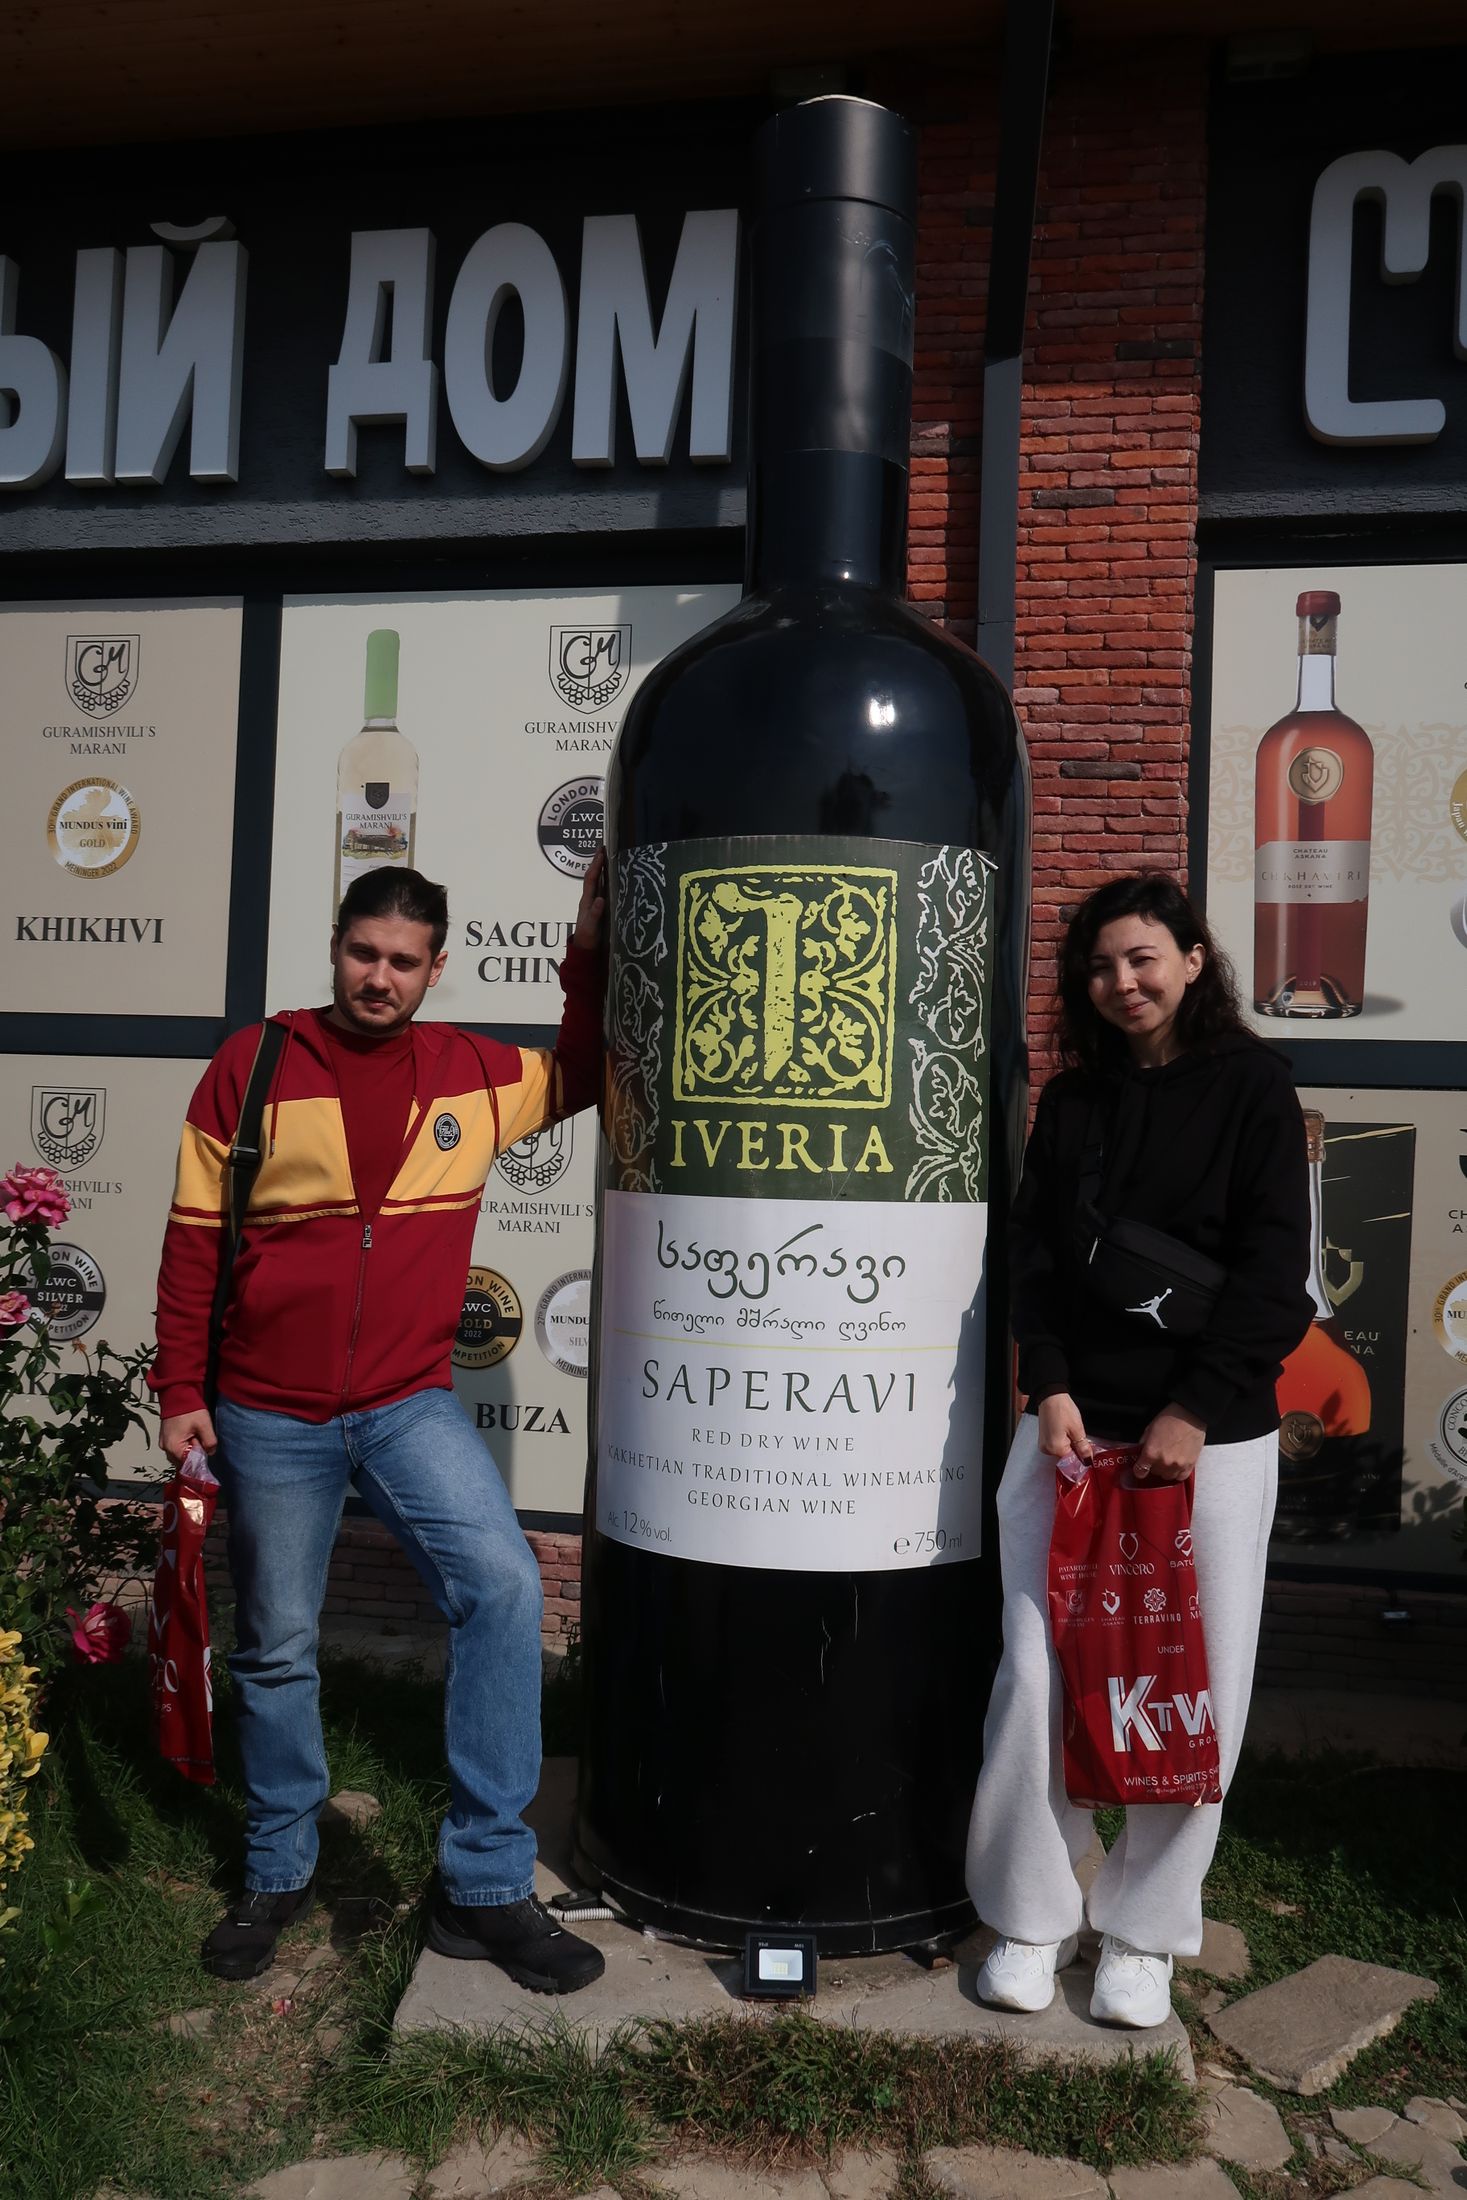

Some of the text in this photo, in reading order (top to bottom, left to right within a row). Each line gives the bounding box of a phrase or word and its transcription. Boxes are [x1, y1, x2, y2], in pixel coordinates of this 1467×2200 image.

[325, 207, 743, 475] ДОМ
[42, 726, 156, 738] GURAMISHVILI'S
[524, 721, 618, 734] GURAMISHV
[70, 743, 126, 754] MARANI
[555, 739, 613, 751] MARAN
[547, 785, 599, 821] LONDON
[59, 818, 128, 830] MUNDUS vini
[562, 828, 603, 839] SILVE
[79, 838, 106, 848] GOLD
[578, 840, 596, 848] 2022
[15, 916, 165, 944] KHIKHVI
[477, 956, 566, 983] CHIN
[670, 1119, 895, 1174] IVERIA
[64, 1180, 123, 1194] SHVILI'S
[69, 1198, 92, 1210] ANI
[479, 1201, 594, 1217] URAMISHVILI'S
[498, 1219, 561, 1234] MARANI
[657, 1219, 907, 1304] საფერავი
[74, 1256, 98, 1289] WINE
[37, 1291, 84, 1304] SILVER
[488, 1280, 515, 1314] WINE
[458, 1318, 493, 1329] OLD
[550, 1315, 590, 1326] MUNDU
[653, 1299, 907, 1341] წითელი მშრალი ღვინო
[463, 1329, 482, 1338] 2022
[568, 1336, 590, 1347] SILV
[451, 1341, 506, 1361] MPETITION
[555, 1357, 588, 1376] MEINING
[642, 1359, 916, 1414] SAPERAVI
[474, 1402, 571, 1434] BUZA
[692, 1428, 855, 1452] RED DRY WINE
[608, 1443, 966, 1488] KAKHETIAN TRADITIONAL WINEMAKING
[1093, 1457, 1115, 1469] EARS
[687, 1489, 856, 1515] GEORGIAN WINE
[1133, 1613, 1182, 1625] TERRAVINO
[1157, 1645, 1185, 1654] UNDER
[1124, 1776, 1159, 1786] WINES
[1161, 1776, 1169, 1786] &
[1172, 1771, 1208, 1785] SPIRITS
